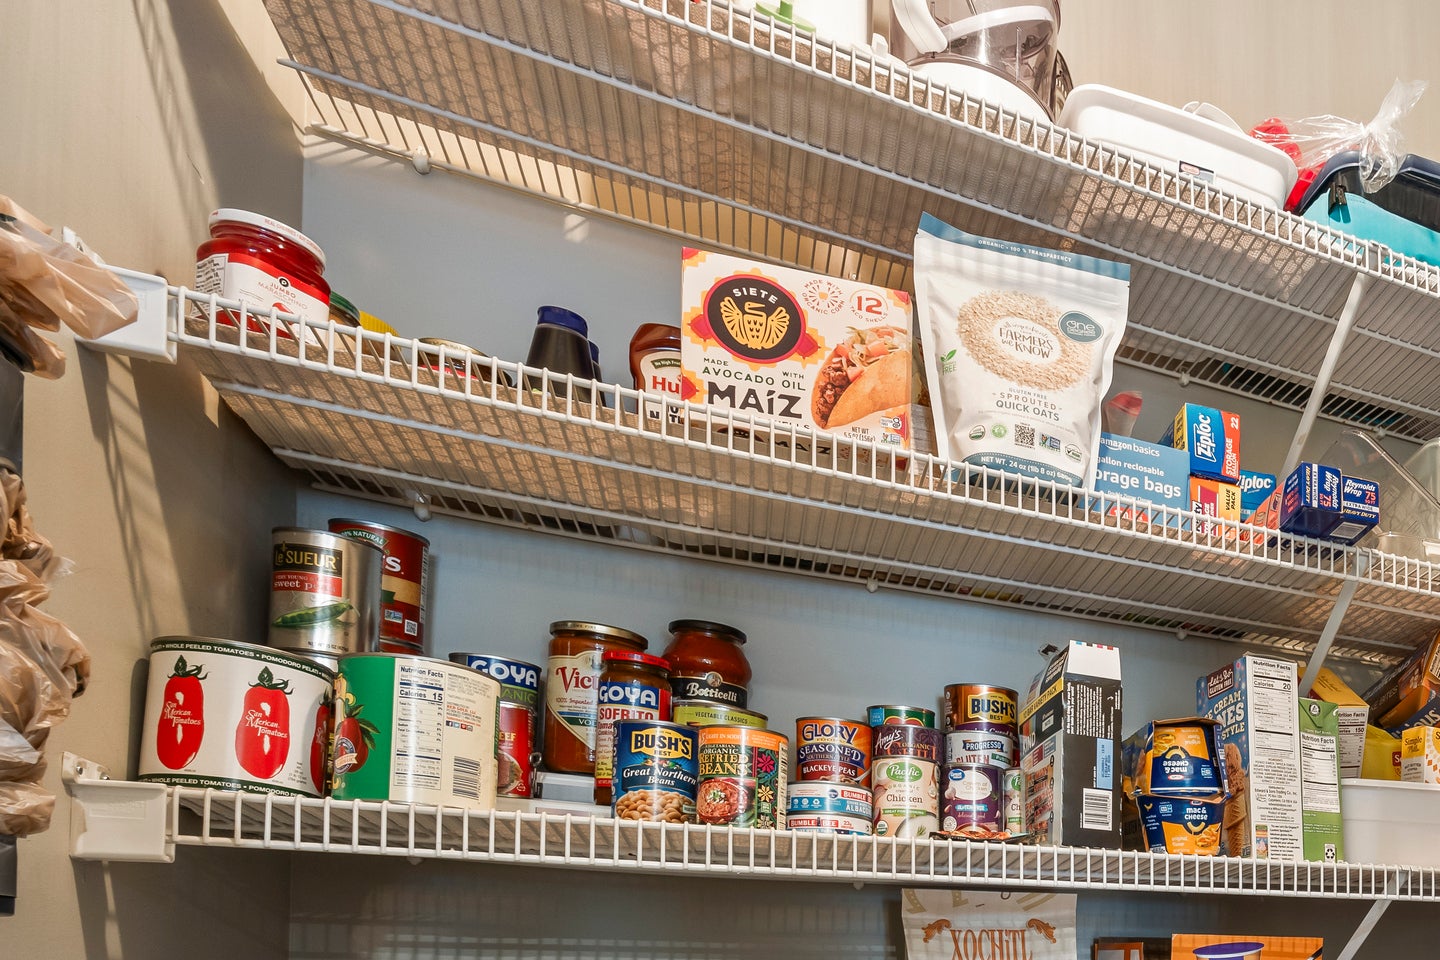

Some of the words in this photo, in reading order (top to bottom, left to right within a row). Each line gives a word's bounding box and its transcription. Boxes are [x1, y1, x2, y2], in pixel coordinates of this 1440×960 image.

[1028, 249, 1073, 264] TRANSPARENCY
[732, 287, 778, 304] SIETE
[857, 295, 882, 315] 12
[1015, 341, 1051, 359] KNOW
[703, 357, 729, 366] MADE
[702, 366, 775, 386] AVOCADO
[782, 379, 806, 391] OIL
[782, 371, 805, 380] WITH
[1000, 392, 1056, 410] SPROUTED
[996, 400, 1029, 413] QUICK
[1032, 407, 1060, 421] OATS
[1133, 443, 1160, 457] basics
[1225, 437, 1233, 475] STORAGE
[1124, 462, 1165, 476] reclosable
[1144, 478, 1182, 498] bags
[1331, 474, 1340, 509] Reynolds
[1343, 485, 1362, 498] Wrap
[1365, 491, 1376, 501] 75
[1346, 479, 1376, 492] Reynolds
[352, 531, 384, 545] NATURAL
[286, 552, 337, 570] SUEUR
[274, 580, 301, 588] sweet
[185, 643, 212, 651] PEELED
[213, 646, 255, 657] TOMATOES
[261, 654, 301, 669] POMODORO
[427, 669, 443, 678] Facts
[686, 682, 738, 703] Botticelli
[1282, 682, 1292, 691] 20
[432, 692, 443, 701] 15
[599, 685, 656, 706] GOYA
[1214, 691, 1242, 715] CREAM
[599, 707, 654, 720] SOFRITO
[971, 698, 1016, 719] BUSH'S
[695, 711, 722, 720] VEGETABLE
[723, 715, 748, 724] CLASSICS
[257, 725, 287, 739] Tomatoes
[802, 724, 858, 745] GLORY
[1221, 722, 1245, 741] STYLE
[634, 733, 690, 756] BUSH'S
[966, 740, 1001, 750] PROGRESSO
[699, 753, 749, 763] REFRIED
[799, 744, 861, 762] SEASONED
[623, 767, 650, 778] Great
[652, 768, 697, 786] Northern
[699, 763, 748, 776] BEANS
[838, 766, 856, 777] PEAS
[889, 764, 920, 779] Pacific
[200, 779, 242, 789] TOMATOES
[648, 776, 675, 787] Beans
[886, 793, 923, 804] Chicken
[790, 819, 816, 827] BUMBLE
[822, 819, 838, 828] BEE
